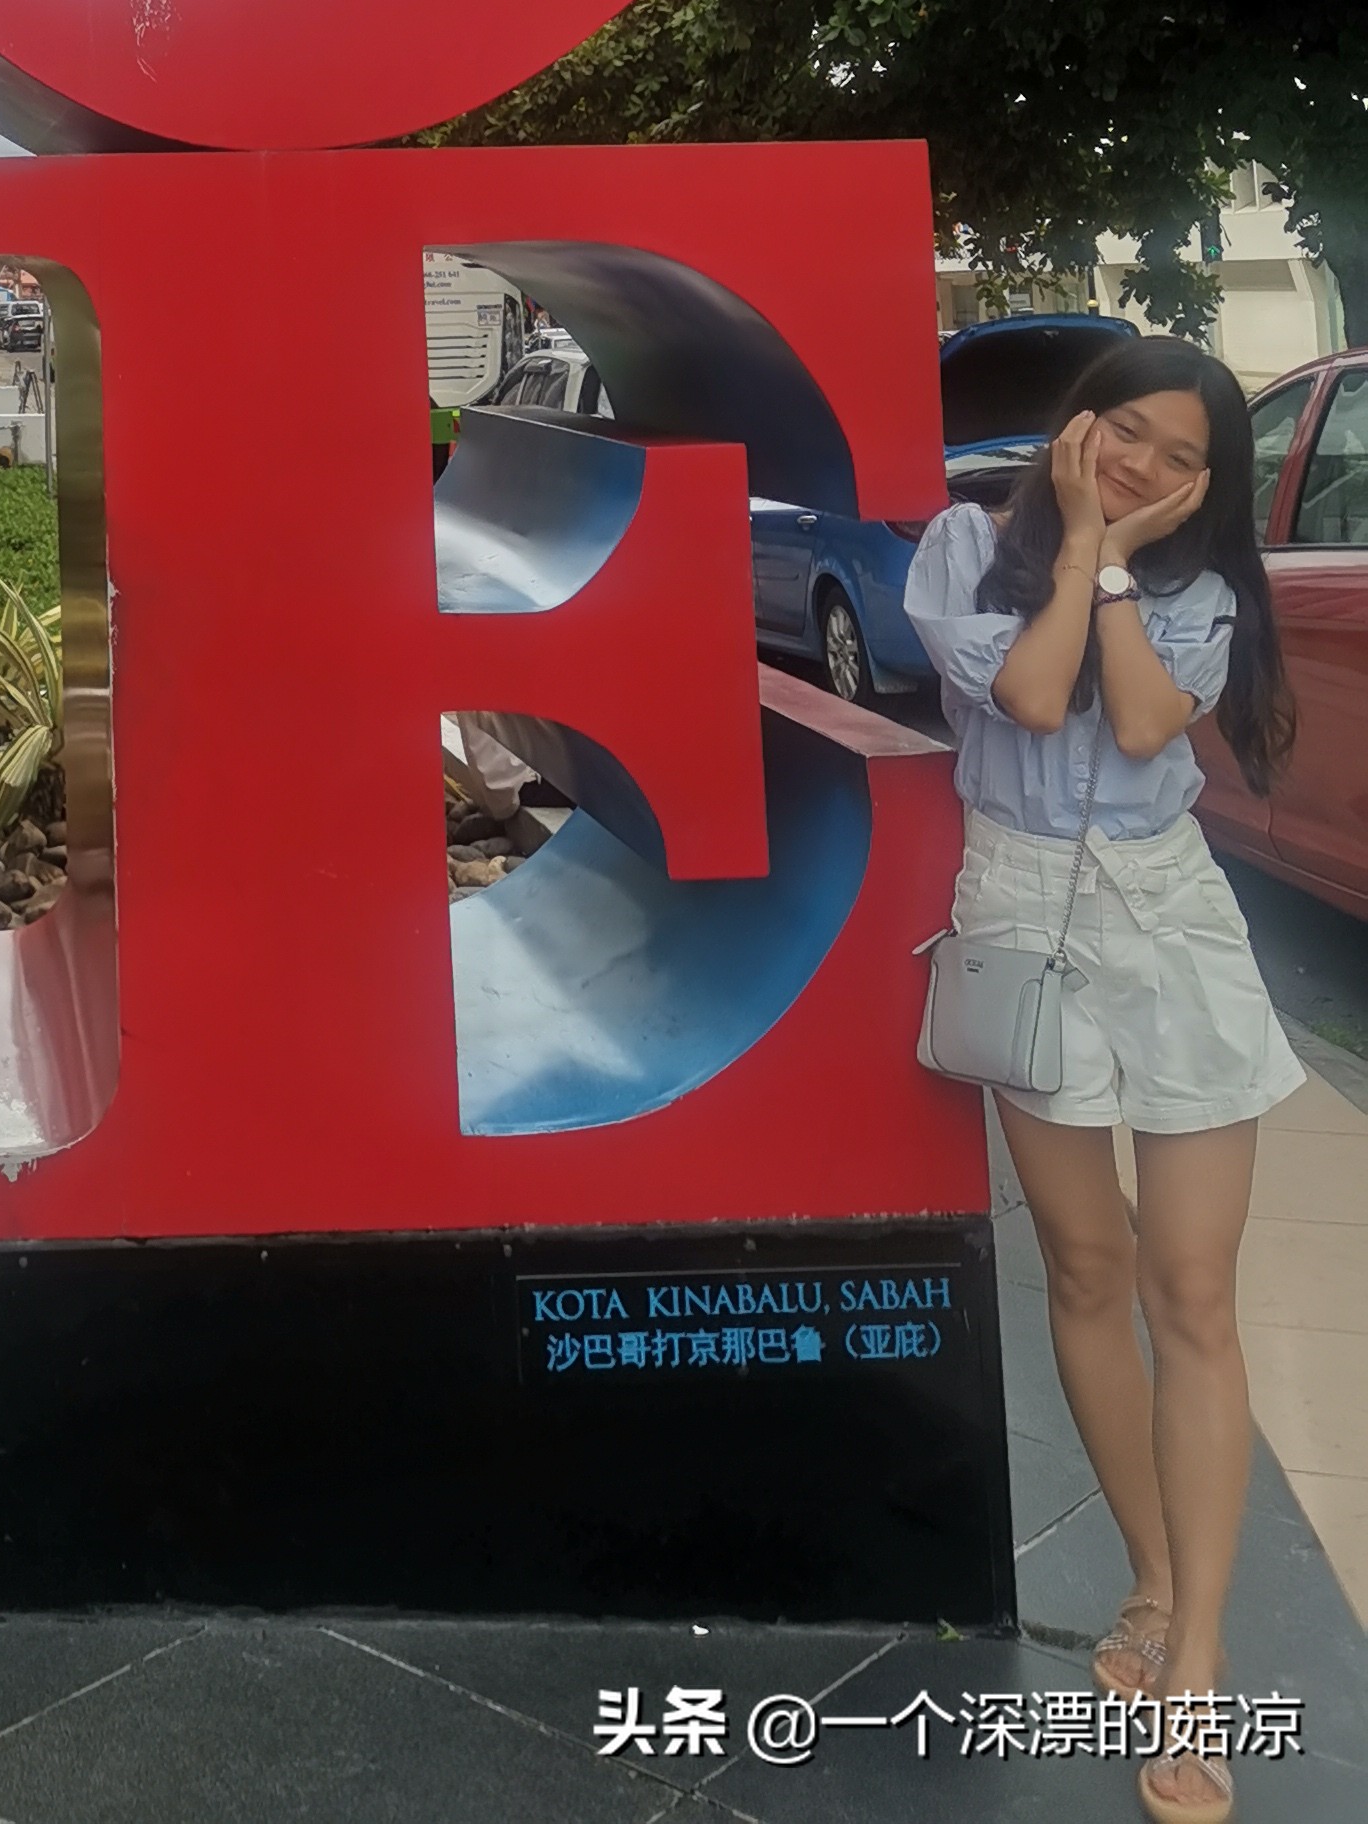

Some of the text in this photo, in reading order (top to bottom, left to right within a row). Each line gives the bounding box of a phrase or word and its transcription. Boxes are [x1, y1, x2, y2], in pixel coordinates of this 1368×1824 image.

[532, 1277, 952, 1322] KOTA KINABALU, SABAH
